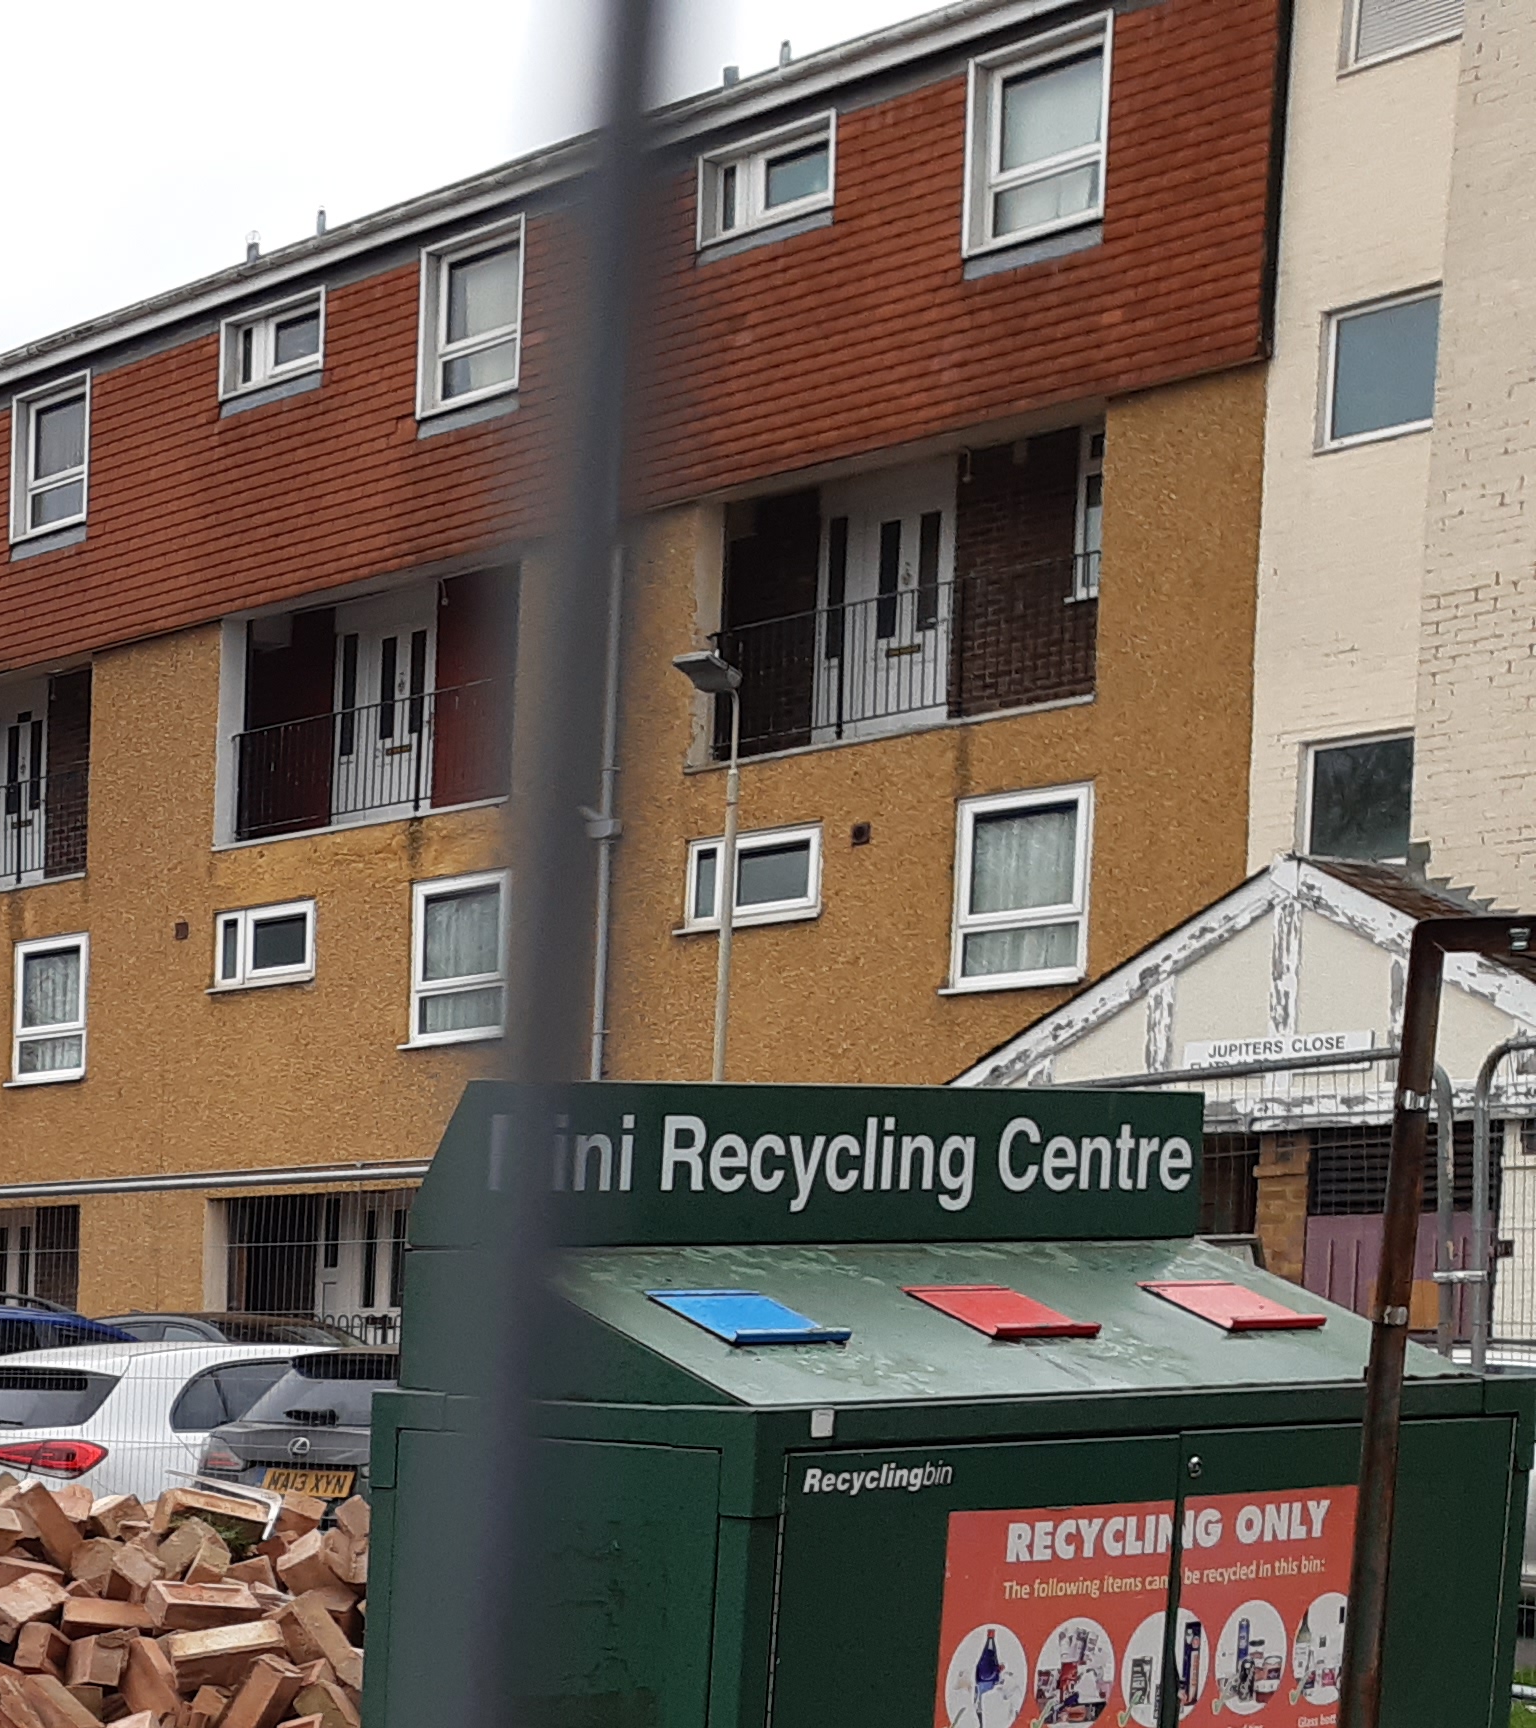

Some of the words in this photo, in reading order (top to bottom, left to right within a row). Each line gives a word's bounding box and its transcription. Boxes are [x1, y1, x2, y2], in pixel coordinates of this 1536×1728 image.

[1208, 1040, 1283, 1059] JUPITERS
[1291, 1035, 1346, 1053] CLOSE
[489, 1113, 635, 1192] ini
[660, 1115, 976, 1213] Recycling
[998, 1117, 1192, 1193] Centre
[309, 1473, 347, 1494] XYN
[803, 1460, 953, 1495] Recyclingbin
[1005, 1507, 1223, 1563] RECYCLING
[1235, 1499, 1331, 1545] ONLY
[1003, 1579, 1030, 1600] The
[1033, 1576, 1100, 1599] following
[1103, 1574, 1142, 1593] items
[1145, 1575, 1169, 1591] can
[1184, 1567, 1200, 1584] be
[1203, 1561, 1256, 1585] recycled
[1259, 1559, 1271, 1577] in
[1275, 1557, 1298, 1576] this
[1301, 1555, 1326, 1574] bin:
[1297, 1716, 1318, 1728] Glass
